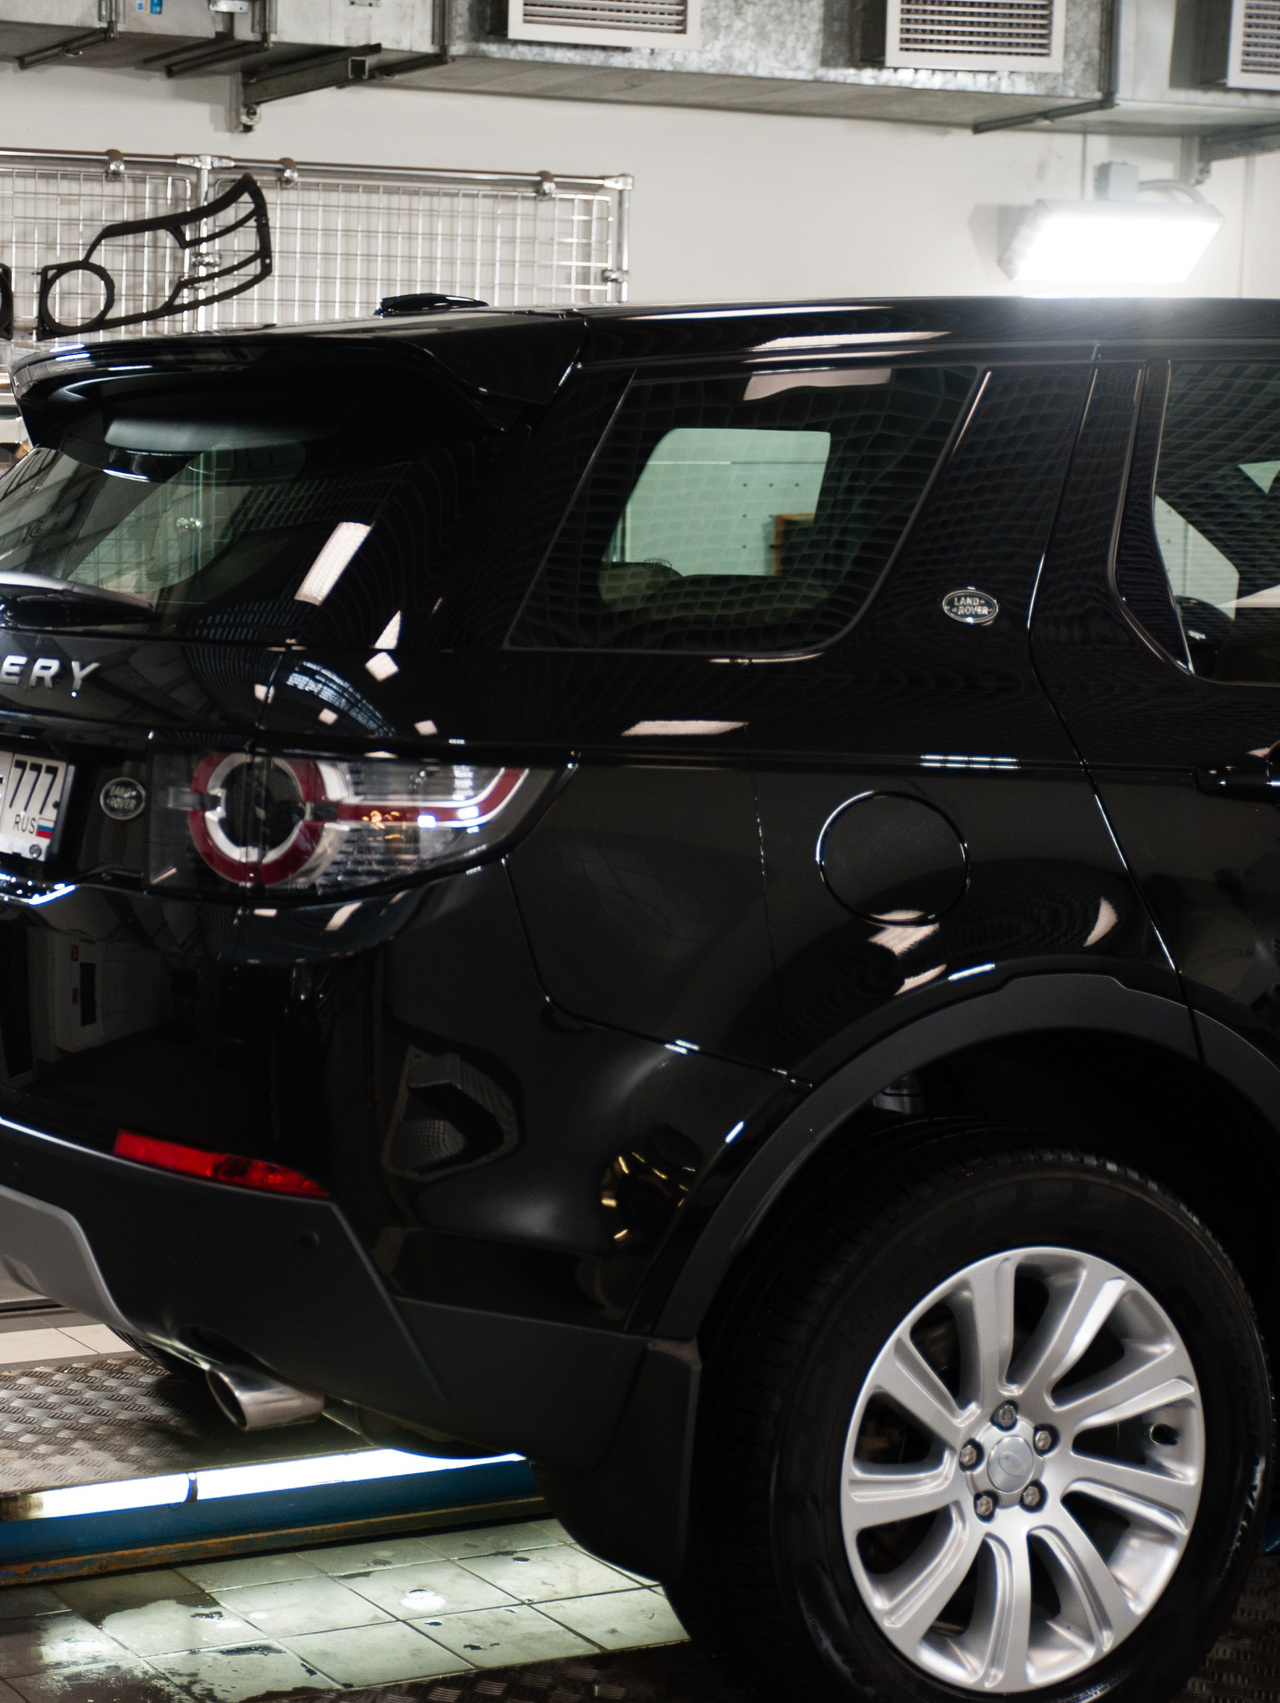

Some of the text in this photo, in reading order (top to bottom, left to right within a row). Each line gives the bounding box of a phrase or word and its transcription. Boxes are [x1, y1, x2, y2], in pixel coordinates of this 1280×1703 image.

[953, 597, 980, 606] LAND
[957, 605, 989, 615] ROVER
[9, 759, 60, 815] 777
[13, 814, 37, 835] RUS
